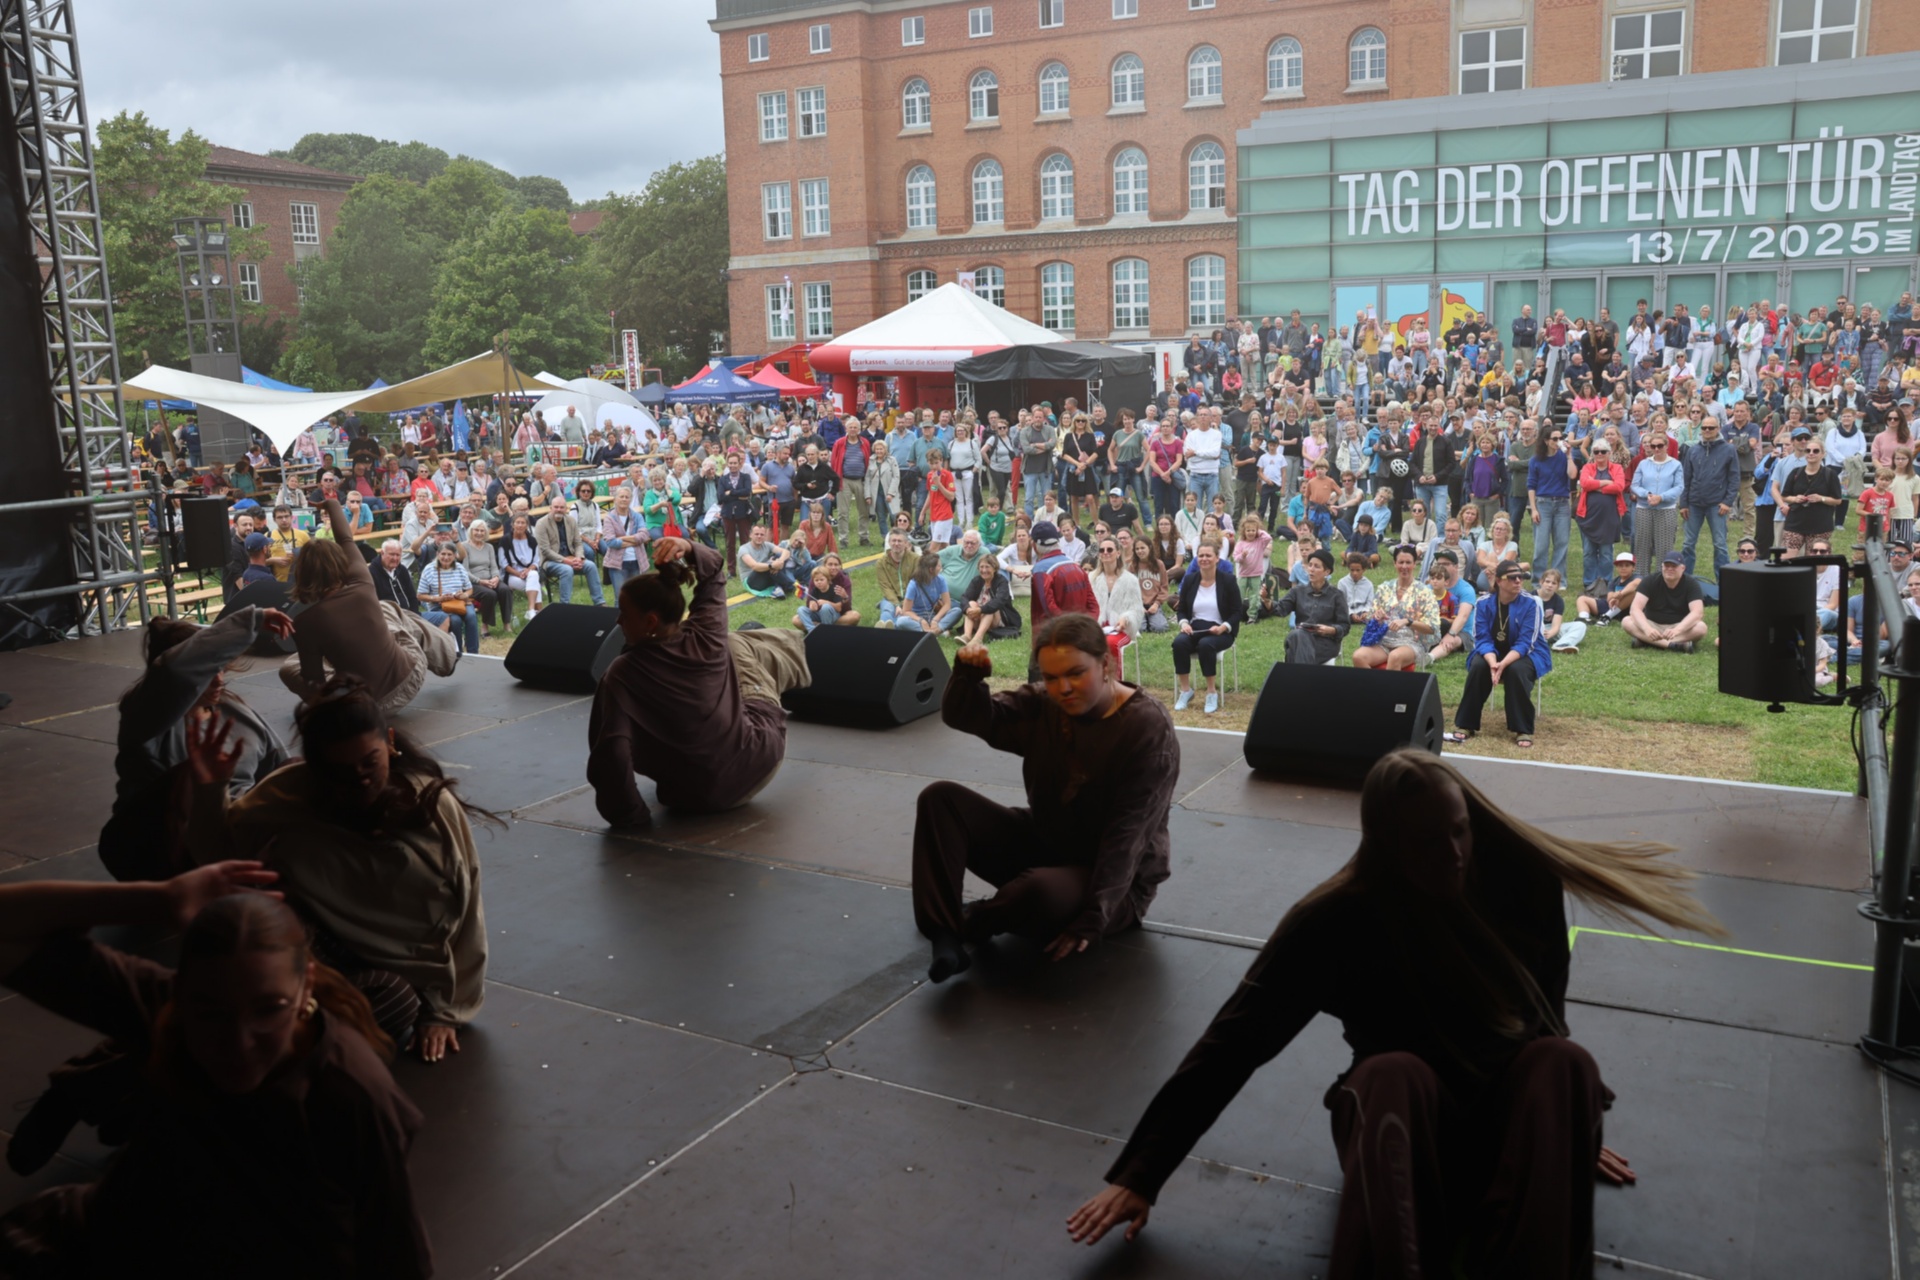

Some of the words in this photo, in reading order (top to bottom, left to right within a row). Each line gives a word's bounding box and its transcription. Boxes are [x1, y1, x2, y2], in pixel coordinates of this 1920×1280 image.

[1339, 169, 1419, 236] TAG
[1437, 163, 1523, 231] DER
[1539, 147, 1759, 226] OFFENEN
[1777, 126, 1885, 213] TÜR
[1887, 134, 1920, 223] LANDTAG
[1884, 228, 1913, 252] IM
[852, 358, 888, 366] Sparkassen.
